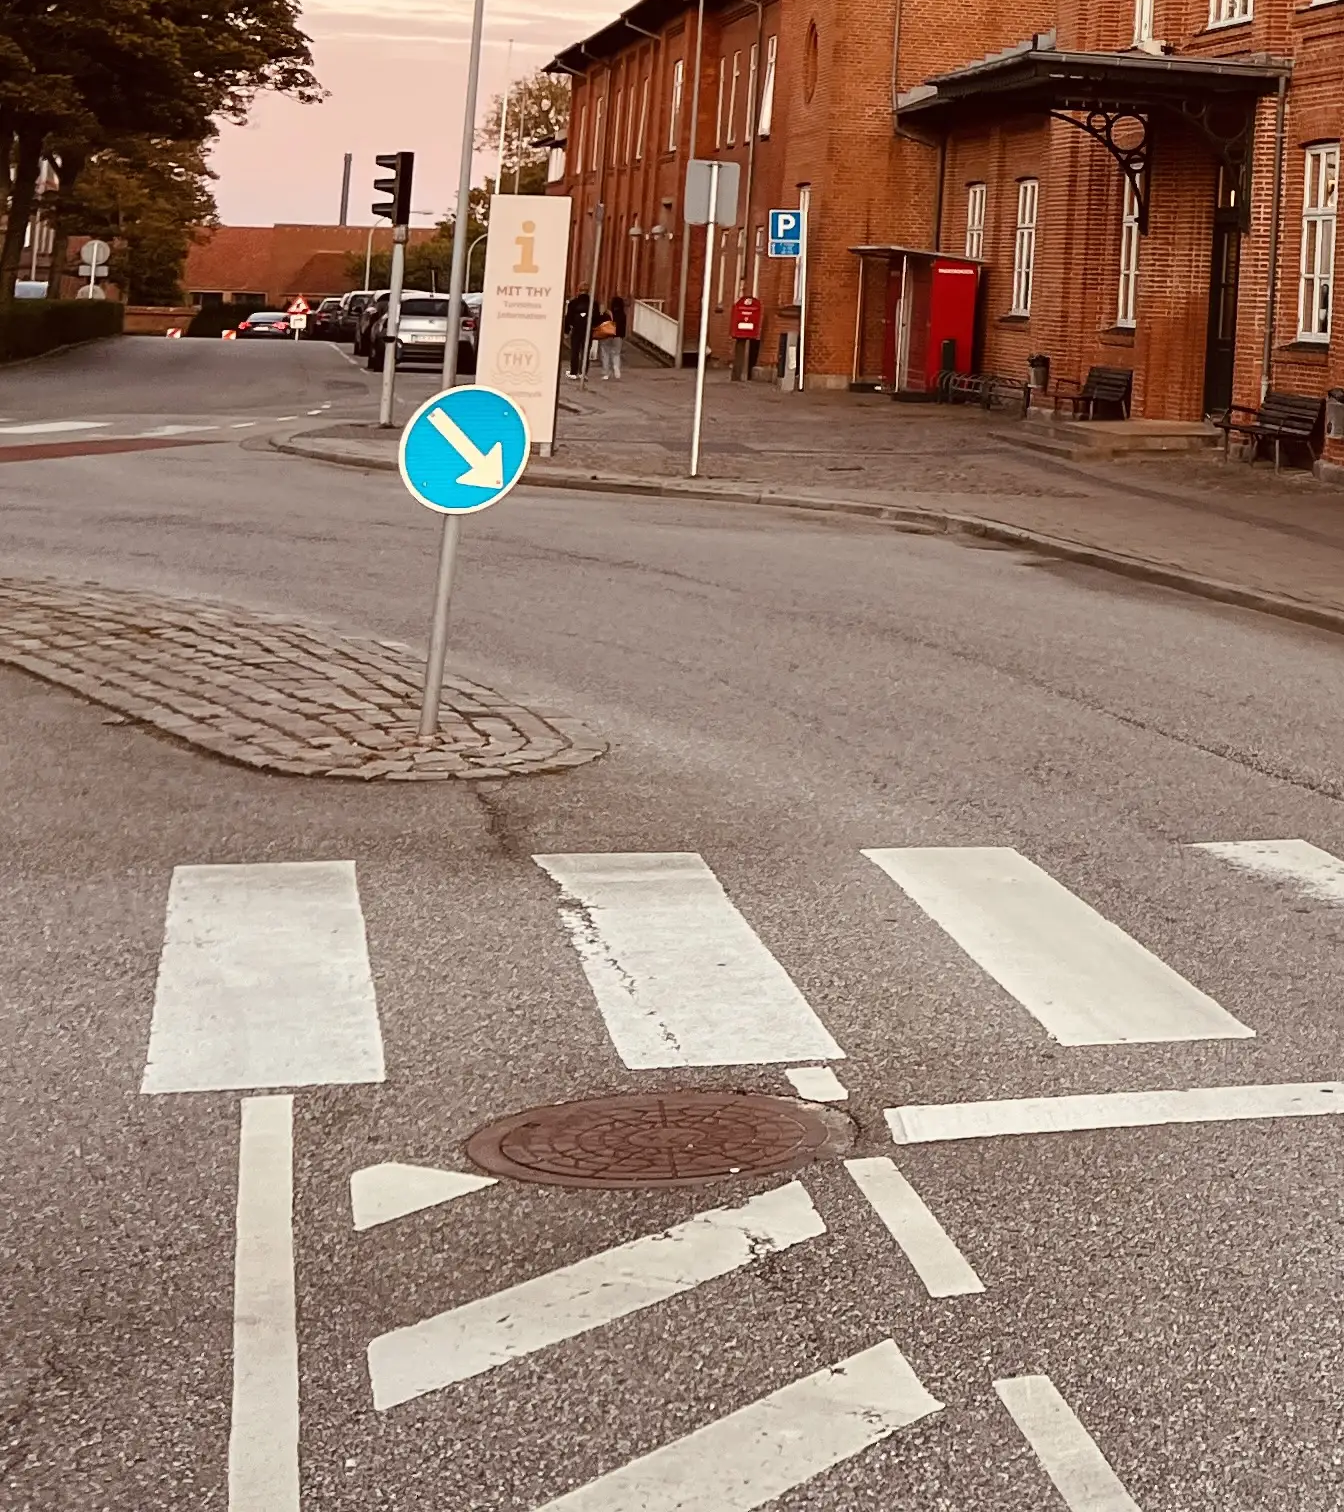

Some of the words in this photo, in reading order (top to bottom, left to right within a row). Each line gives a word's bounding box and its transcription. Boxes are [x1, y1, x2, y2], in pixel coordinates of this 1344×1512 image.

[777, 214, 796, 238] P
[512, 220, 540, 274] i
[496, 285, 522, 297] MIT
[526, 286, 552, 297] THY
[503, 352, 533, 366] THY
